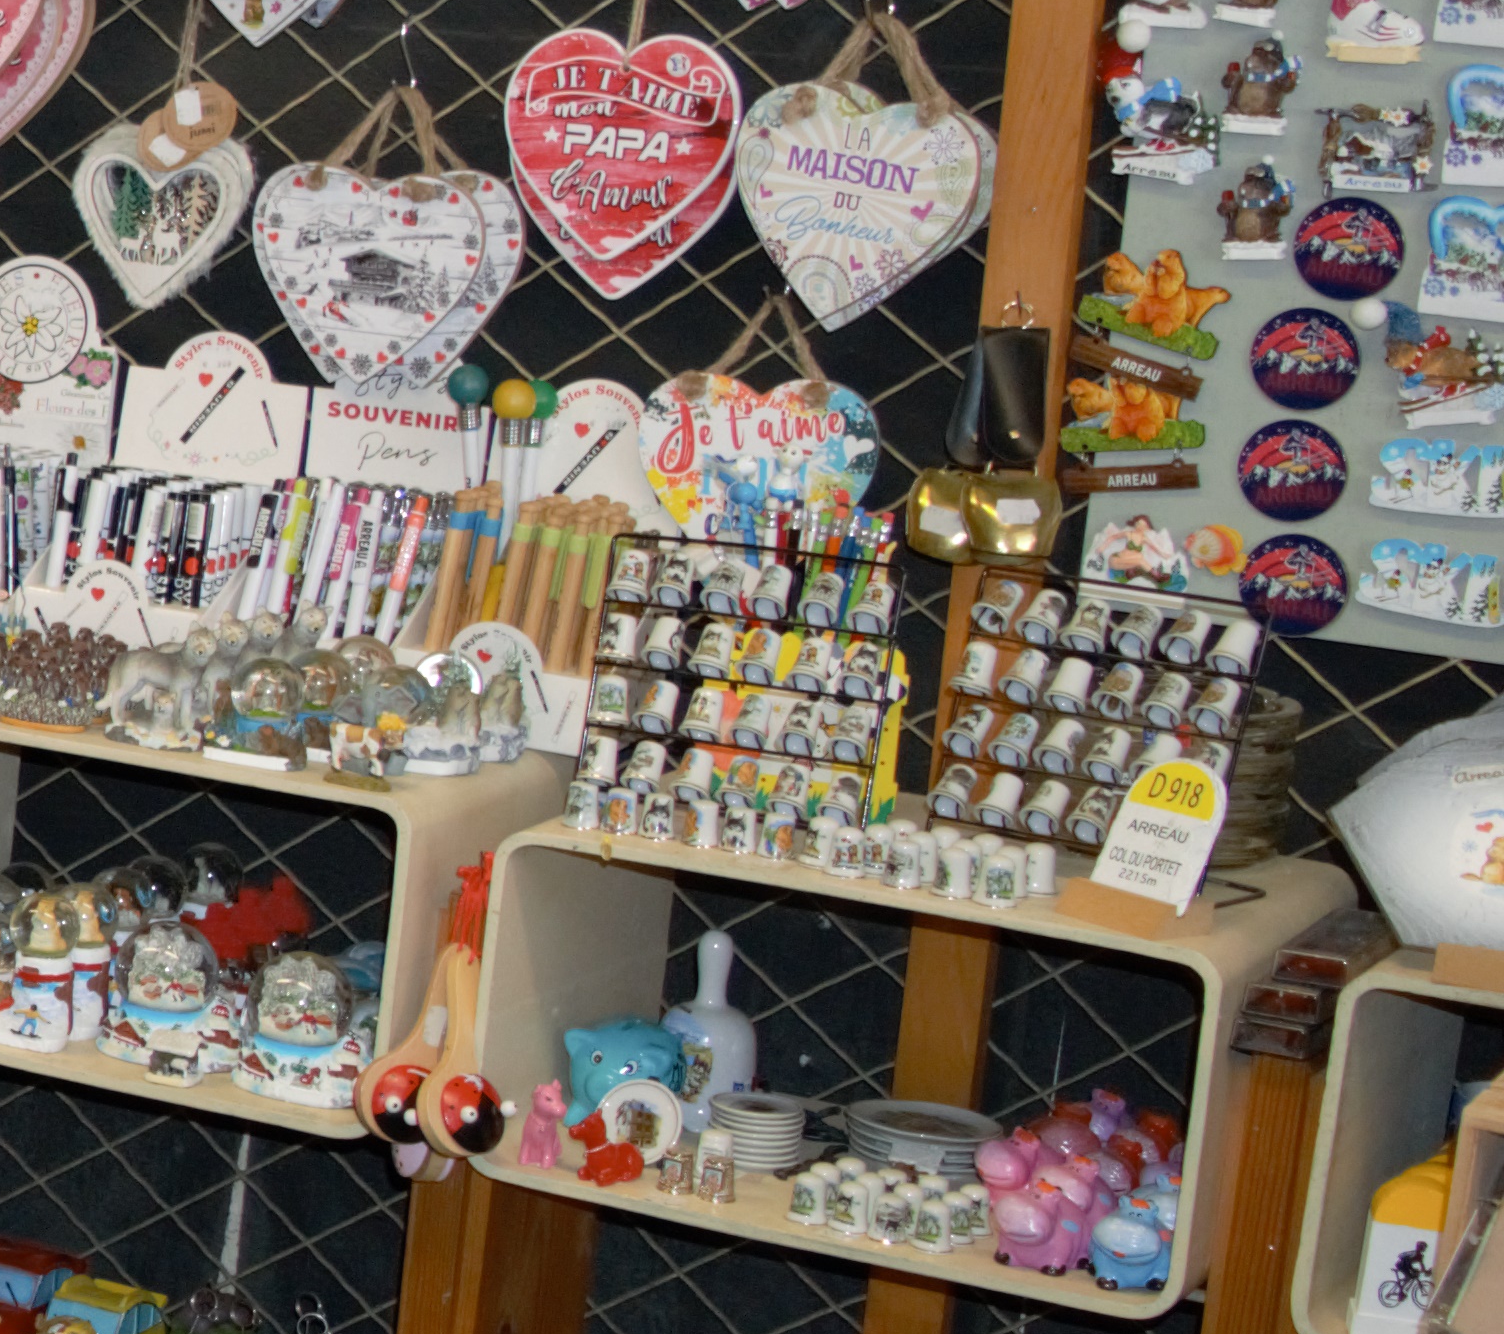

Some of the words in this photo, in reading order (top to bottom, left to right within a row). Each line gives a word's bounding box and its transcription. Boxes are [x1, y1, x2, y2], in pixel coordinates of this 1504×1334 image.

[552, 62, 589, 92] JE
[554, 97, 617, 121] mon
[561, 123, 672, 164] PAPA
[844, 121, 873, 152] LA
[786, 144, 921, 195] MAISON
[1121, 162, 1178, 181] Arreau
[1343, 175, 1403, 192] Arreau
[550, 160, 673, 213] d'Amour
[832, 191, 863, 213] DU
[774, 191, 898, 249] Bonheur
[216, 335, 265, 380] Souvenir
[1110, 356, 1162, 383] ARREAU
[327, 400, 458, 433] SOUVENIR
[726, 406, 847, 452] t'aime
[356, 431, 439, 471] Pens
[1107, 473, 1157, 488] ARREAU
[355, 520, 374, 559] ARREAU
[1166, 778, 1204, 809] 918
[1127, 819, 1189, 844] ARREAU
[1118, 868, 1157, 886] 2215m
[1143, 854, 1182, 877] PORTET
